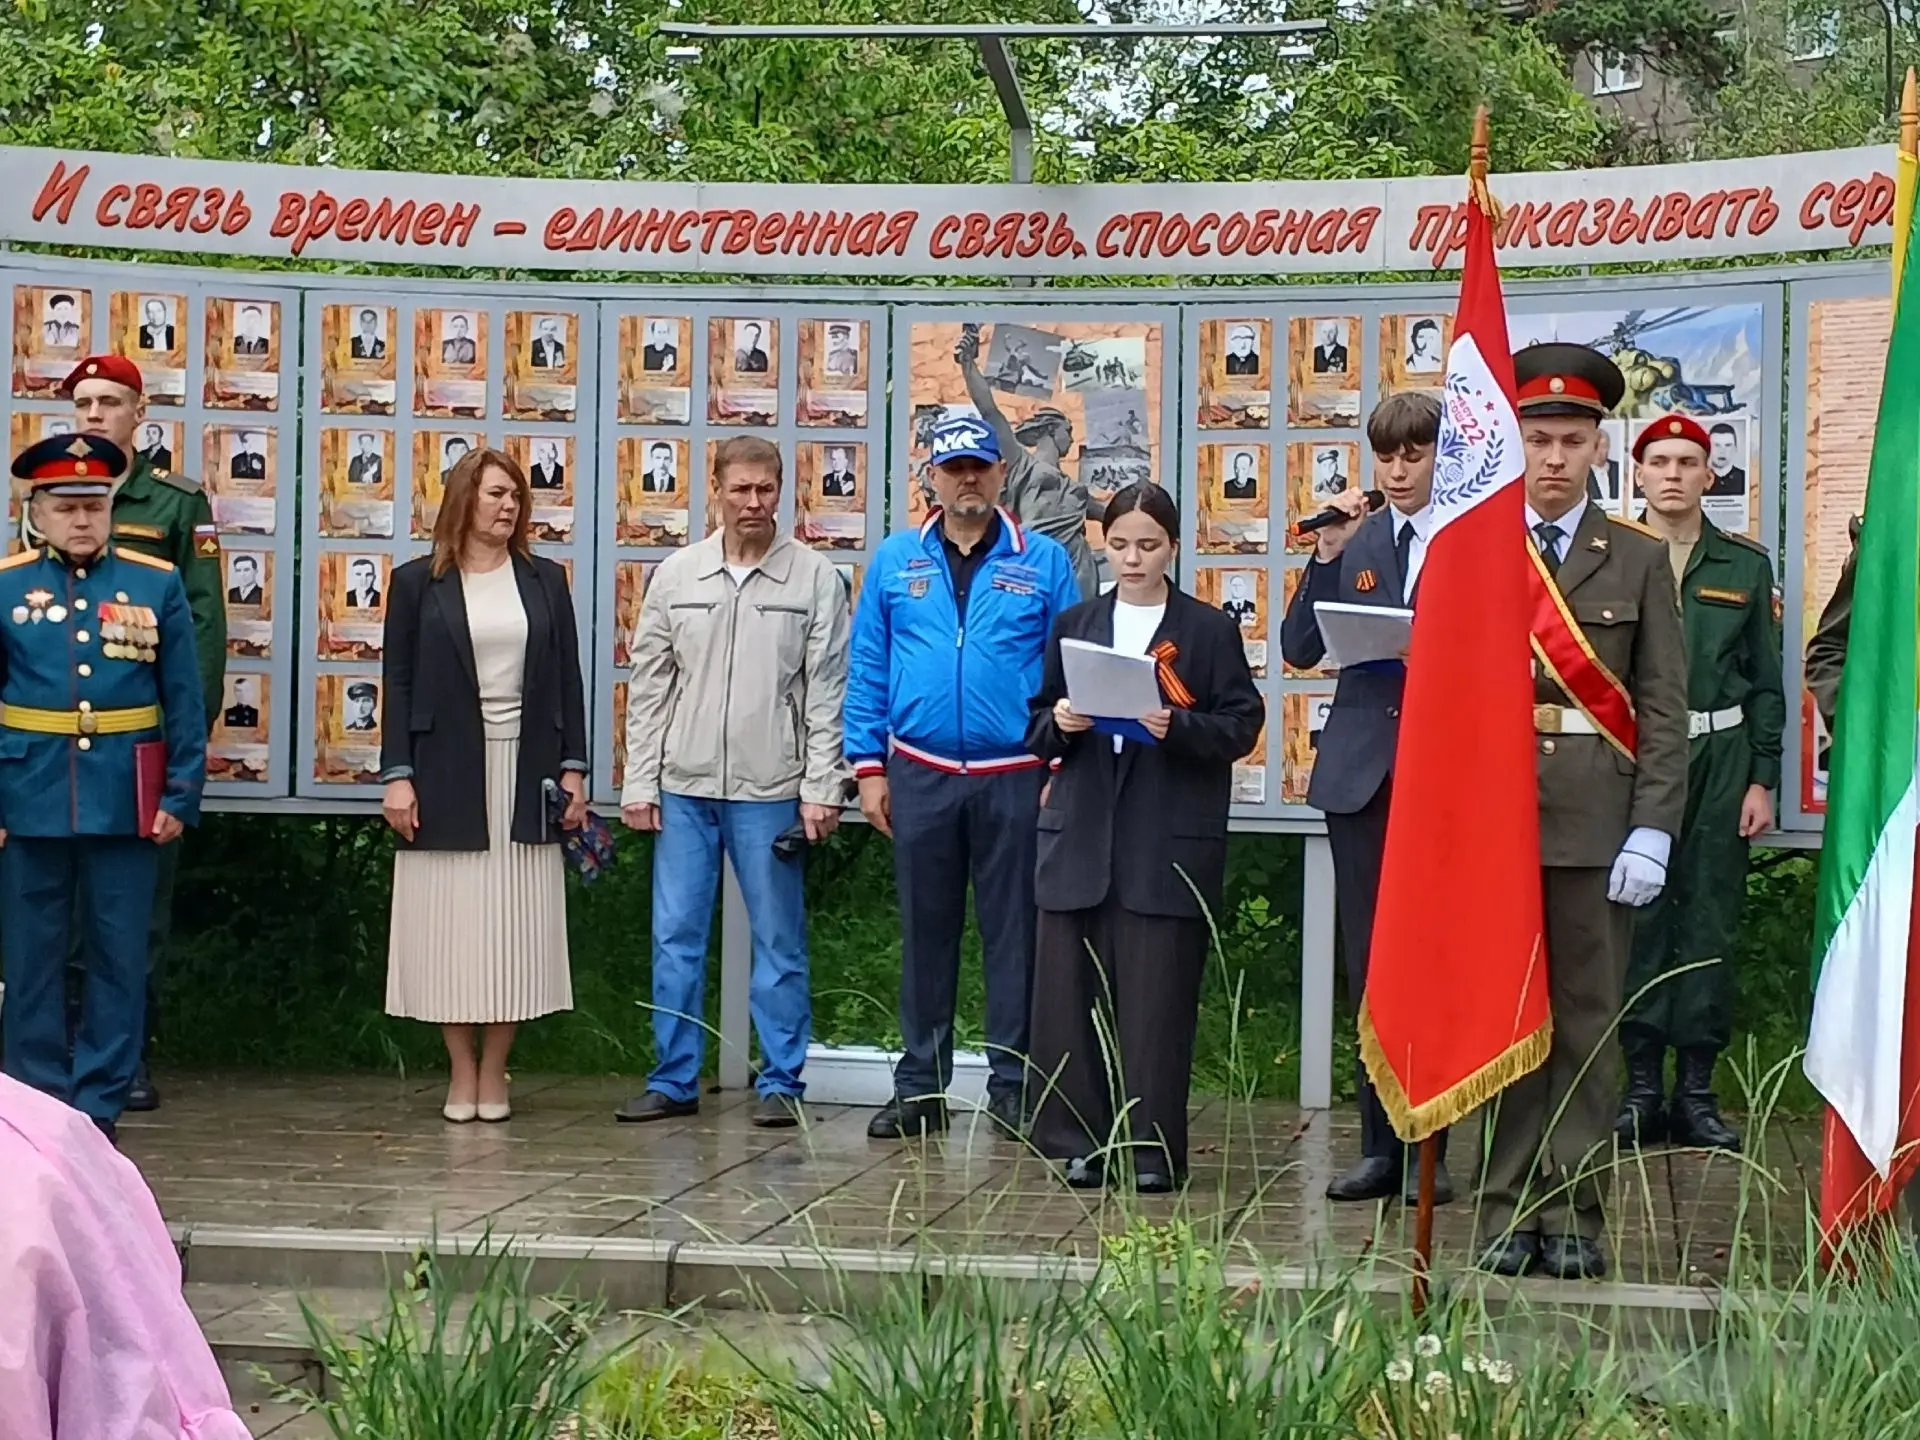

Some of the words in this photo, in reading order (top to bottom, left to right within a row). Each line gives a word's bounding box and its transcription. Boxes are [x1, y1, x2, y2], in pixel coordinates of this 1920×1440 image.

[32, 159, 90, 223] И
[96, 182, 251, 235] связь
[270, 190, 480, 255] времен
[543, 206, 919, 255] единственная
[929, 210, 1086, 258] связь,
[1096, 204, 1381, 256] способная
[1799, 171, 1894, 247] сер
[1461, 418, 1485, 445] 22
